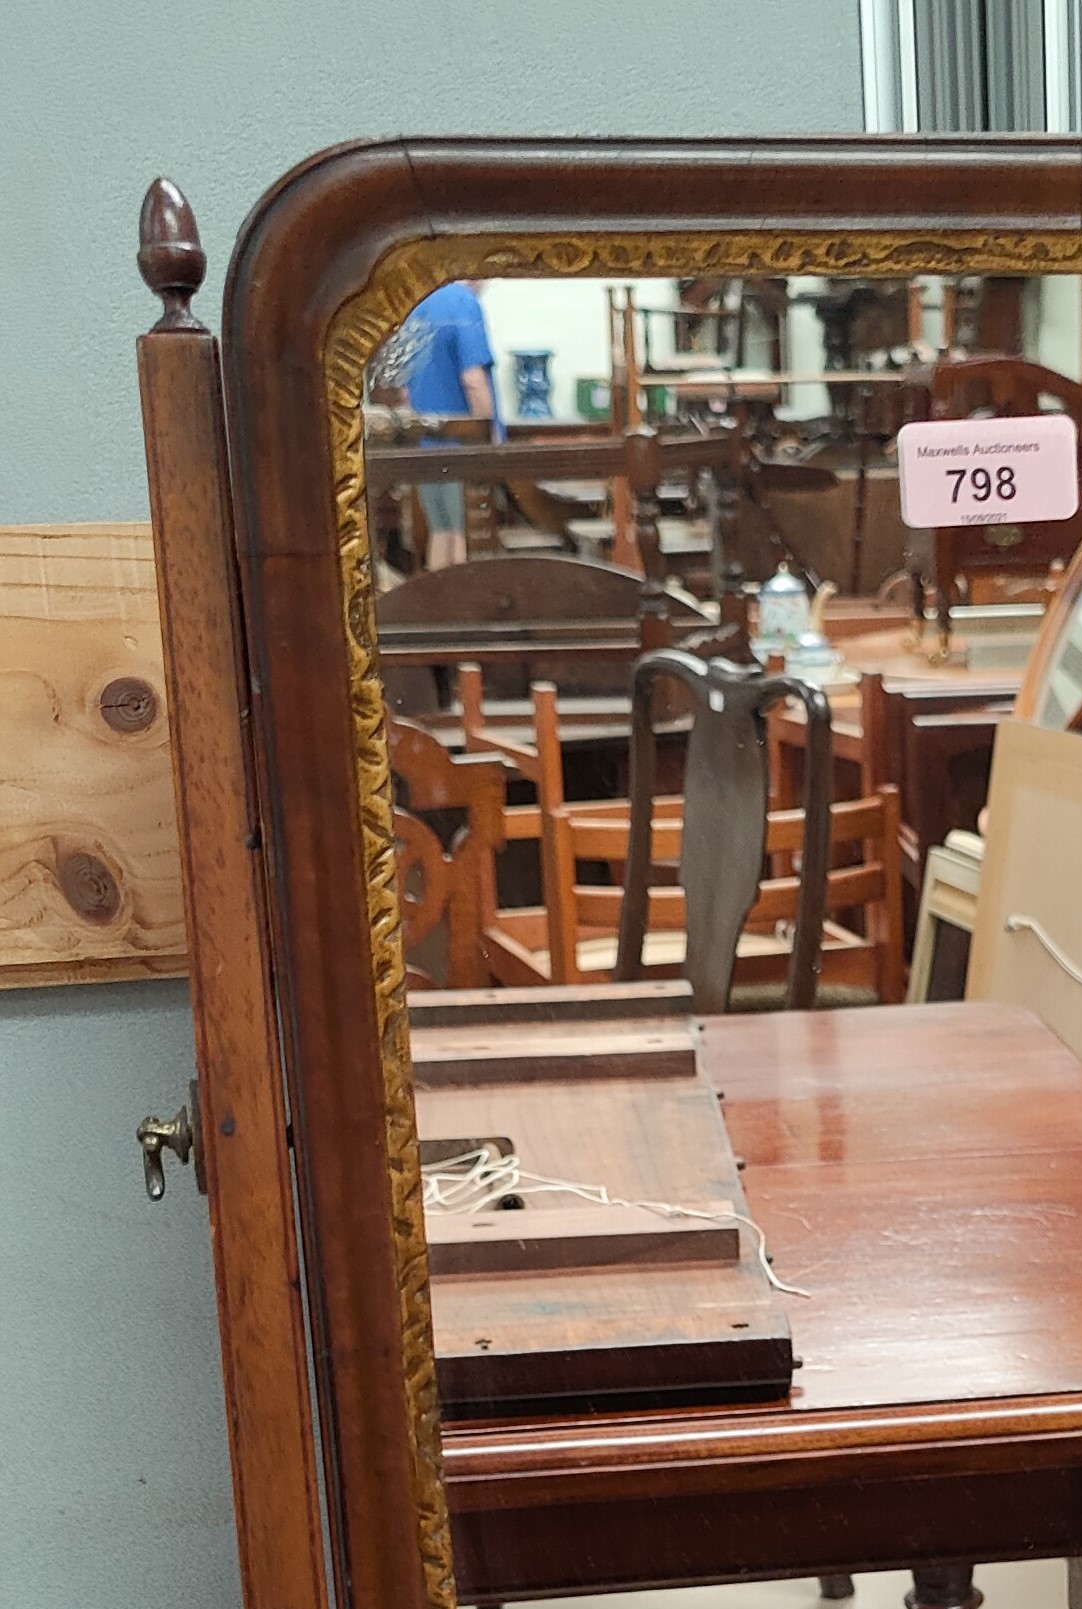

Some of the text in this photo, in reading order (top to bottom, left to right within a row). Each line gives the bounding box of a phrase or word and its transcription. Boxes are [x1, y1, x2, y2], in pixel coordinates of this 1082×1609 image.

[917, 442, 1040, 458] Maxwells Auctioneers
[946, 467, 1016, 503] 798
